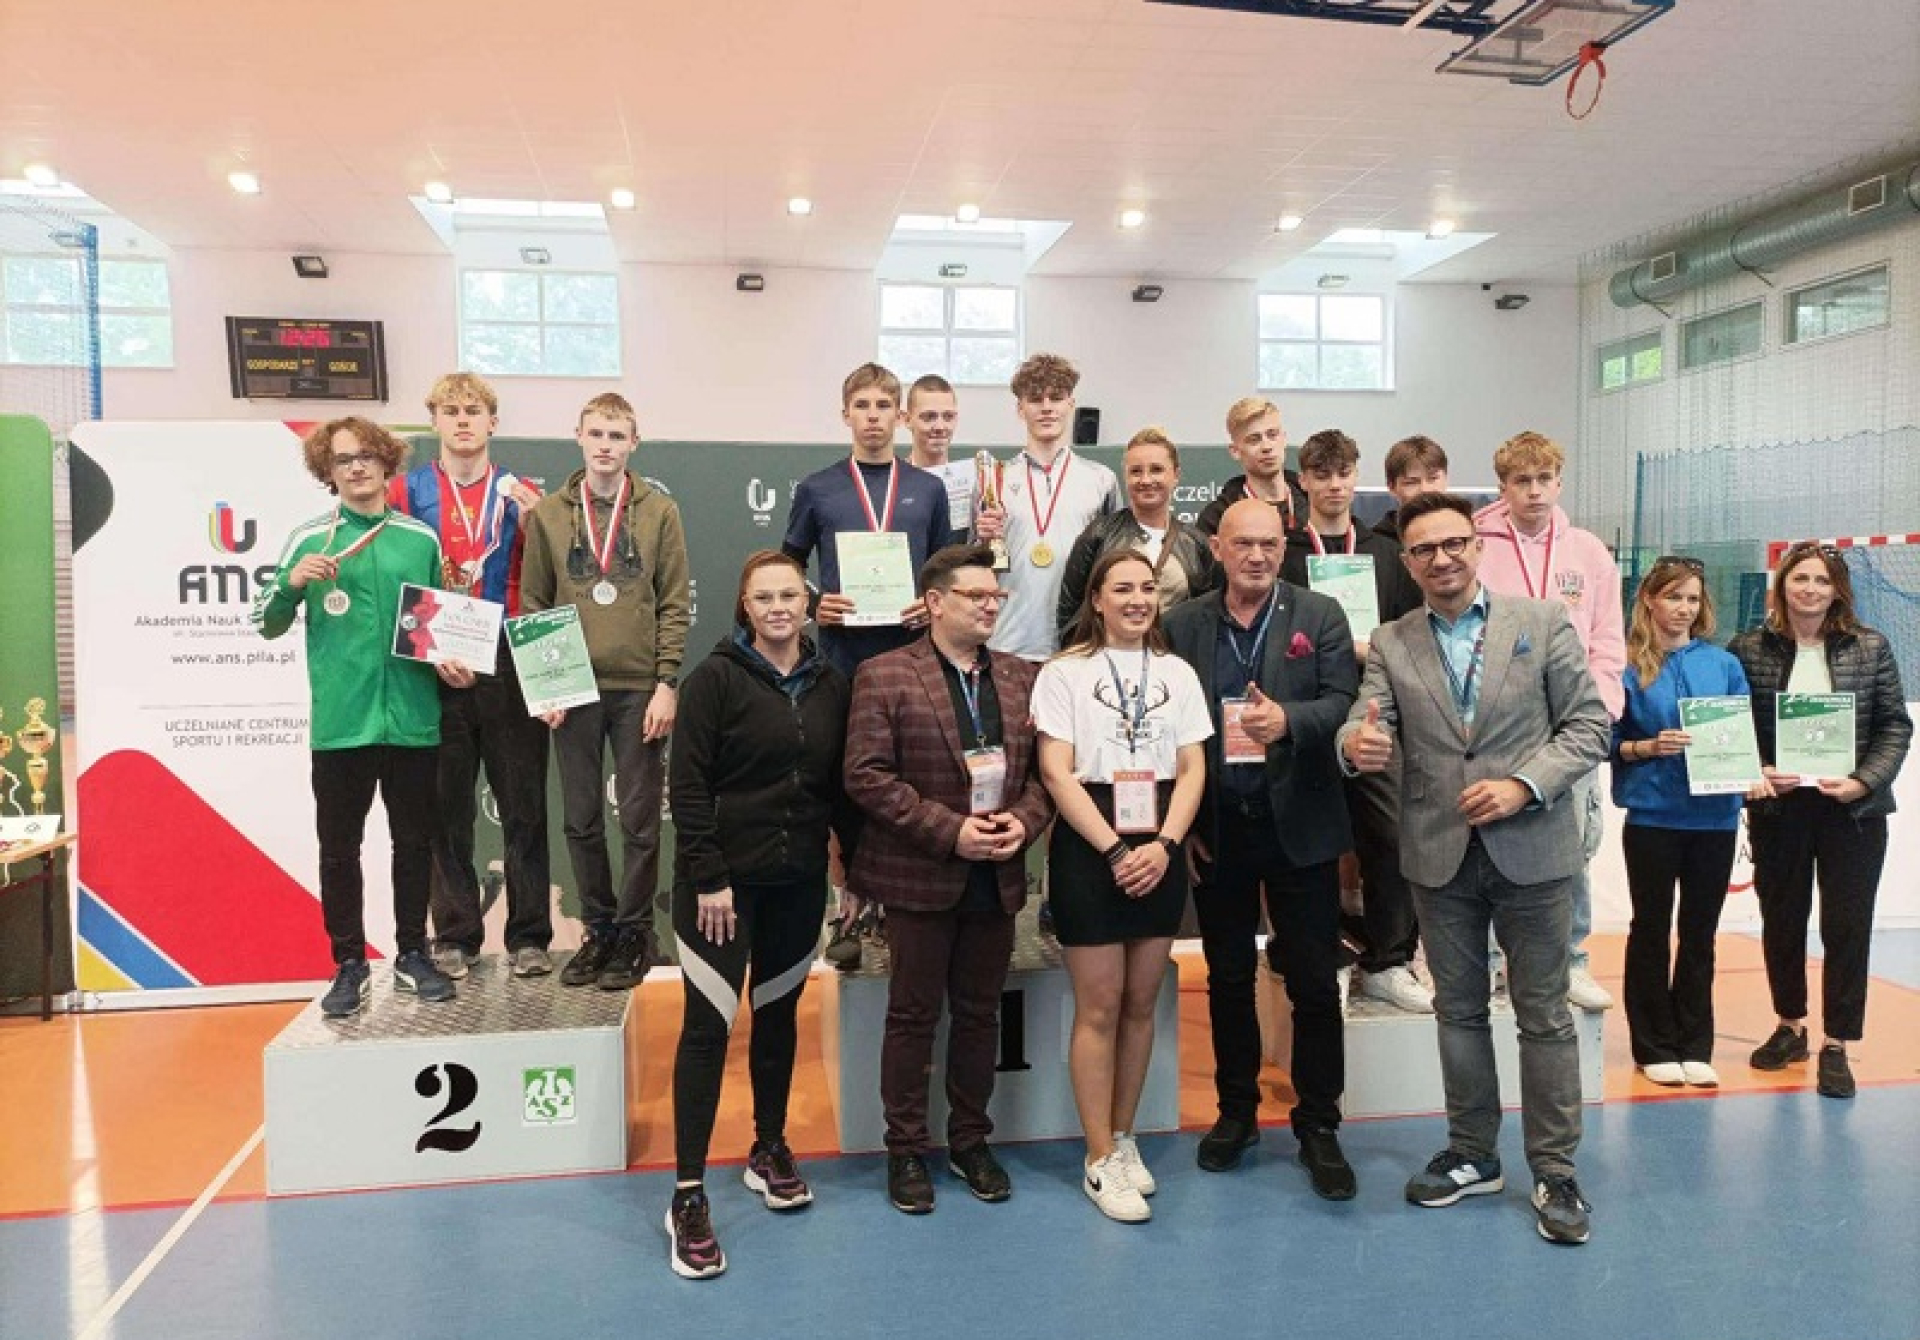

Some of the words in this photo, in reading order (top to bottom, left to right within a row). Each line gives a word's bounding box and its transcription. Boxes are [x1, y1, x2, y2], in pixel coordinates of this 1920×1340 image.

[134, 615, 203, 627] Akademia
[207, 615, 241, 627] Nauk
[165, 718, 245, 732] UCZELNIANE
[249, 717, 308, 731] CENTRUM
[172, 734, 224, 748] SPORTU
[234, 733, 303, 747] REKREACJI
[415, 1062, 482, 1153] 2
